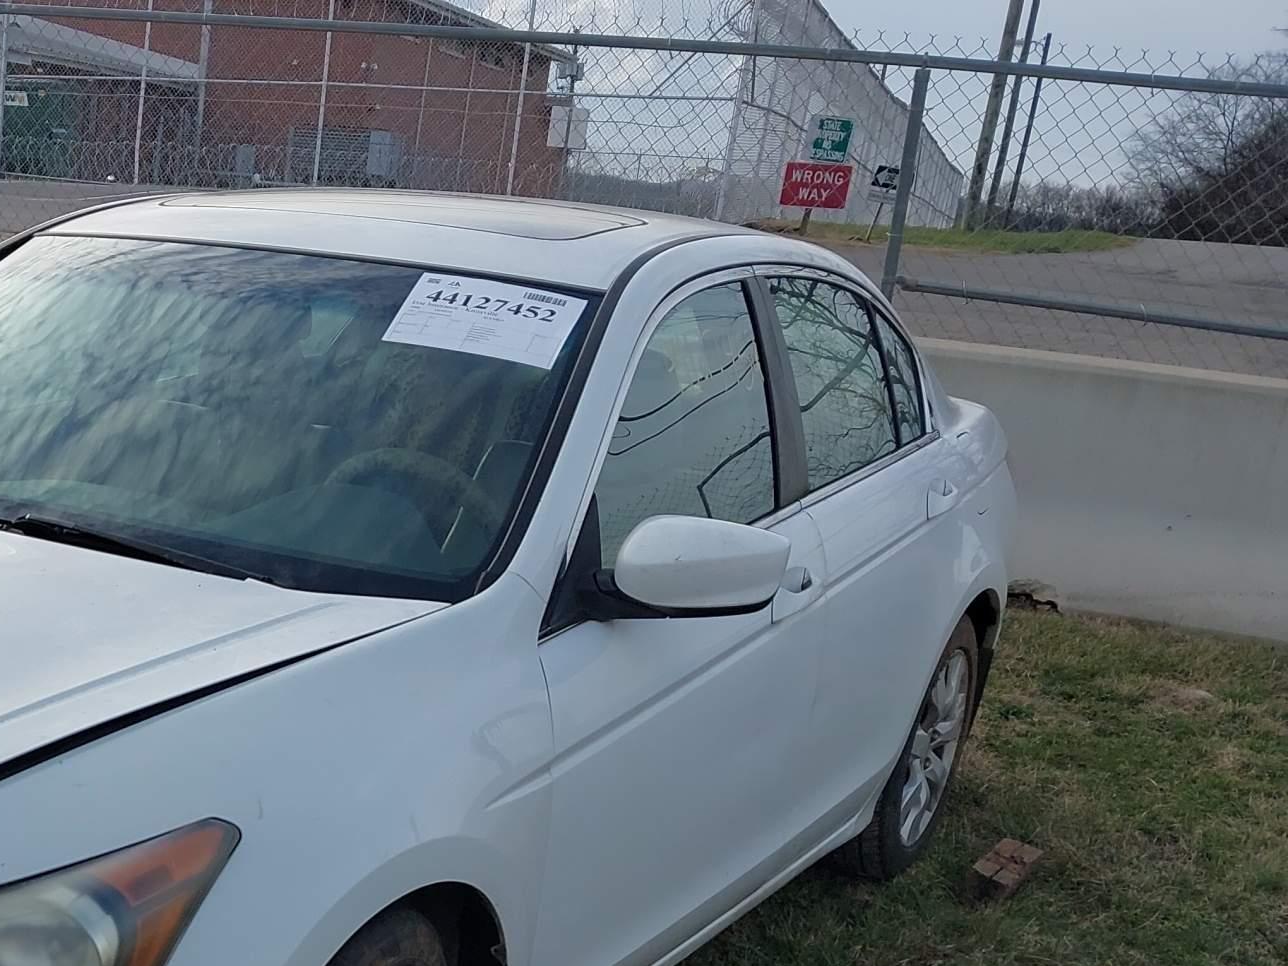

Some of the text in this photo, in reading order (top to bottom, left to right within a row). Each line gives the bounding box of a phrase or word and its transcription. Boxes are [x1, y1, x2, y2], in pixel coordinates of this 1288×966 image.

[822, 120, 843, 131] STATE
[791, 168, 845, 185] WRONG
[798, 186, 832, 201] WAY
[425, 290, 557, 323] 44127452
